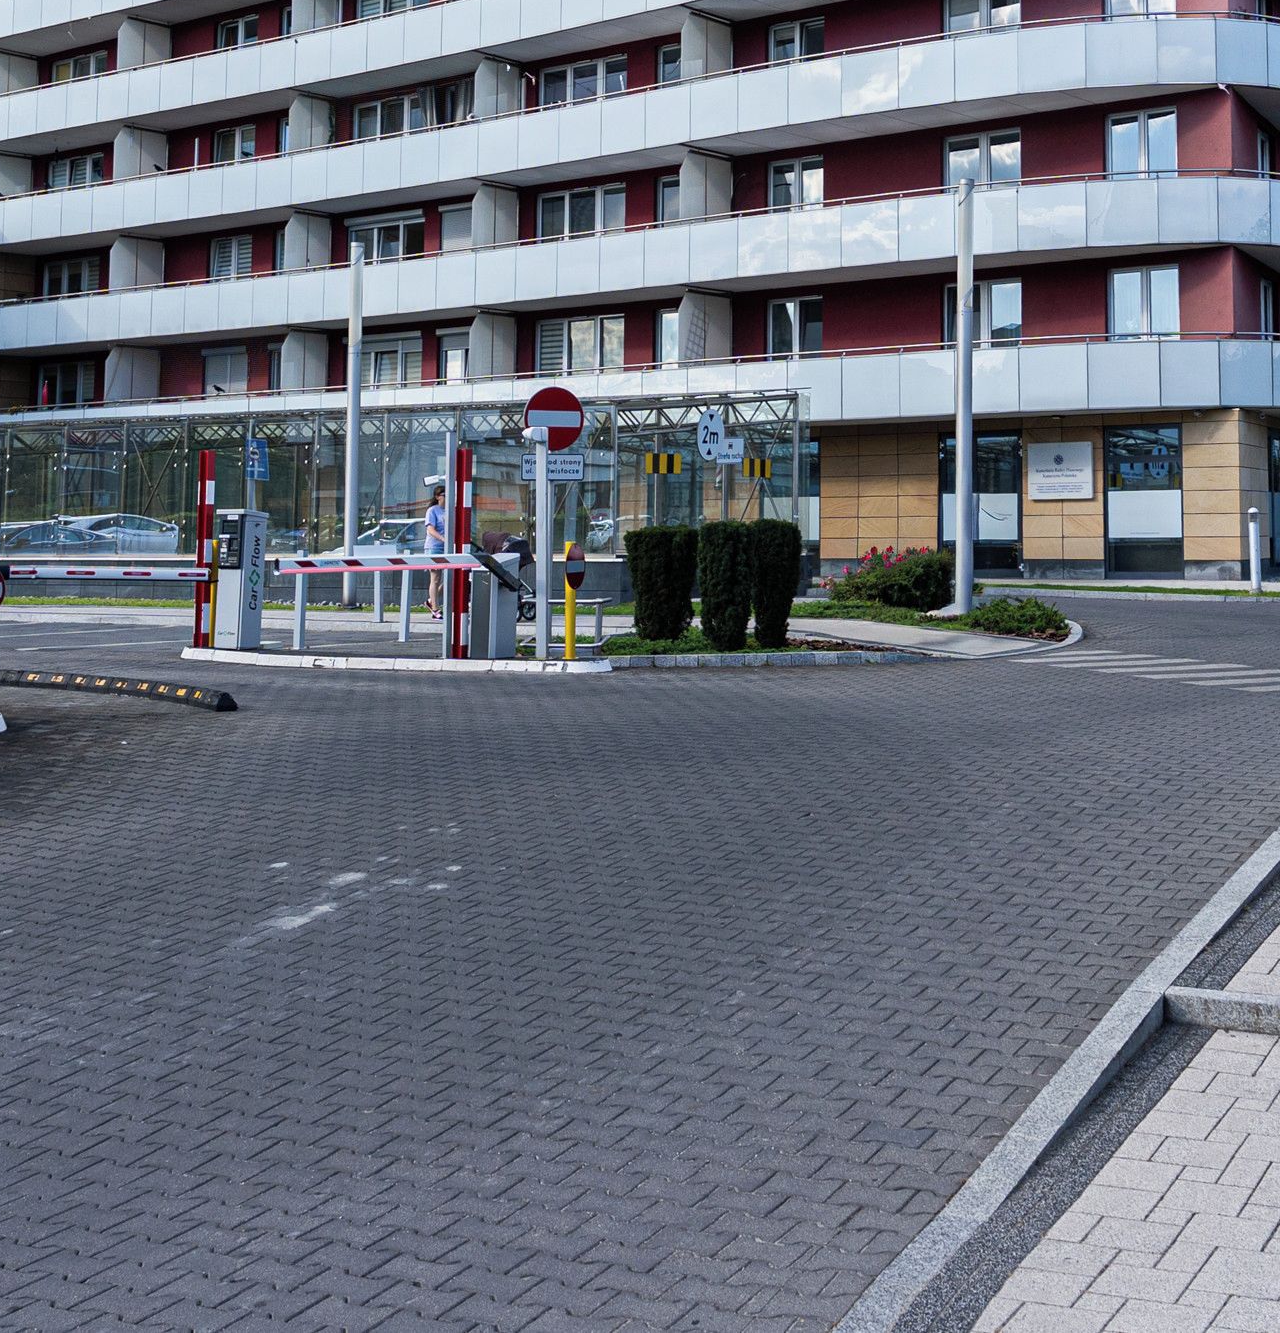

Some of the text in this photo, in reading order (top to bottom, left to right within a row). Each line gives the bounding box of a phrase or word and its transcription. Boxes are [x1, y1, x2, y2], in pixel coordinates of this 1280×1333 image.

[702, 425, 719, 445] 2m
[524, 458, 536, 466] Wja
[560, 459, 582, 467] strony
[249, 535, 261, 611] Car Flow
